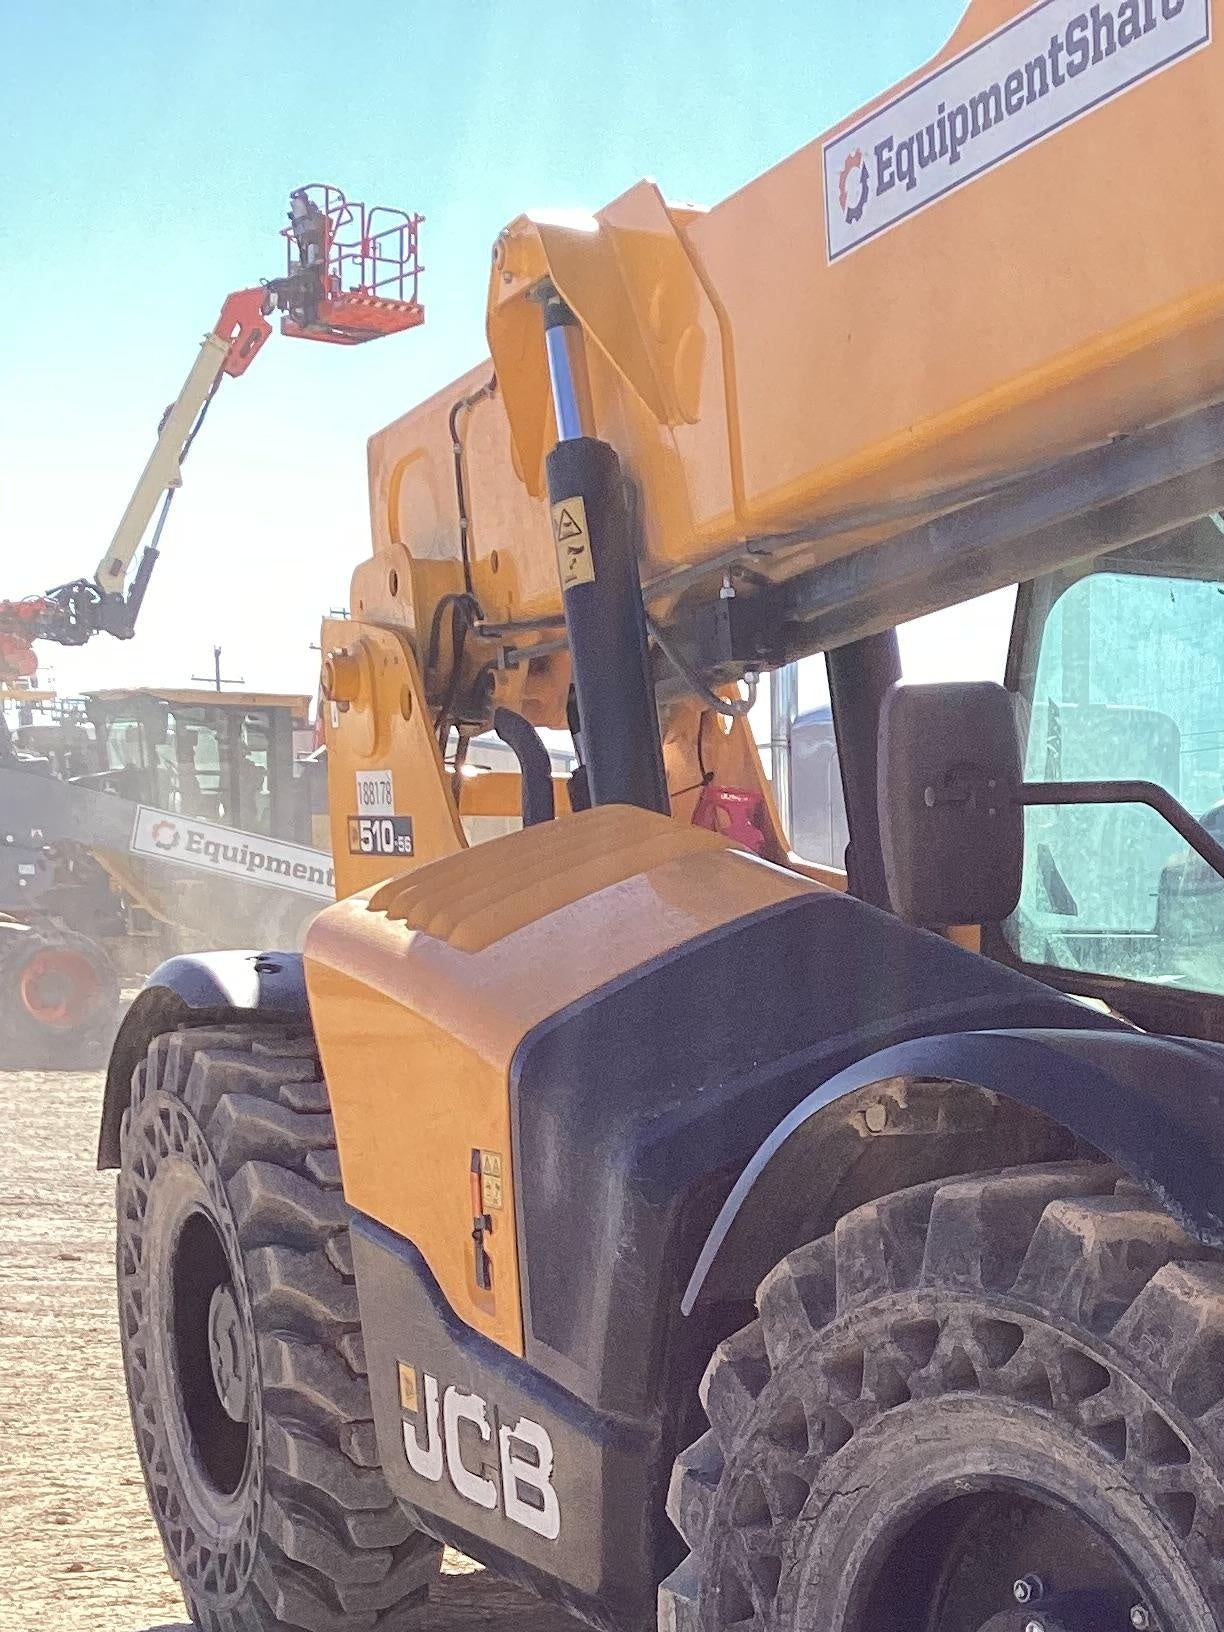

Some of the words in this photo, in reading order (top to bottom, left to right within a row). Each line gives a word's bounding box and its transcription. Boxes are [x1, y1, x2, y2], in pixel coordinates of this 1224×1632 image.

[358, 781, 392, 806] 188178
[184, 829, 335, 887] Equipment
[401, 1371, 561, 1541] JCB
